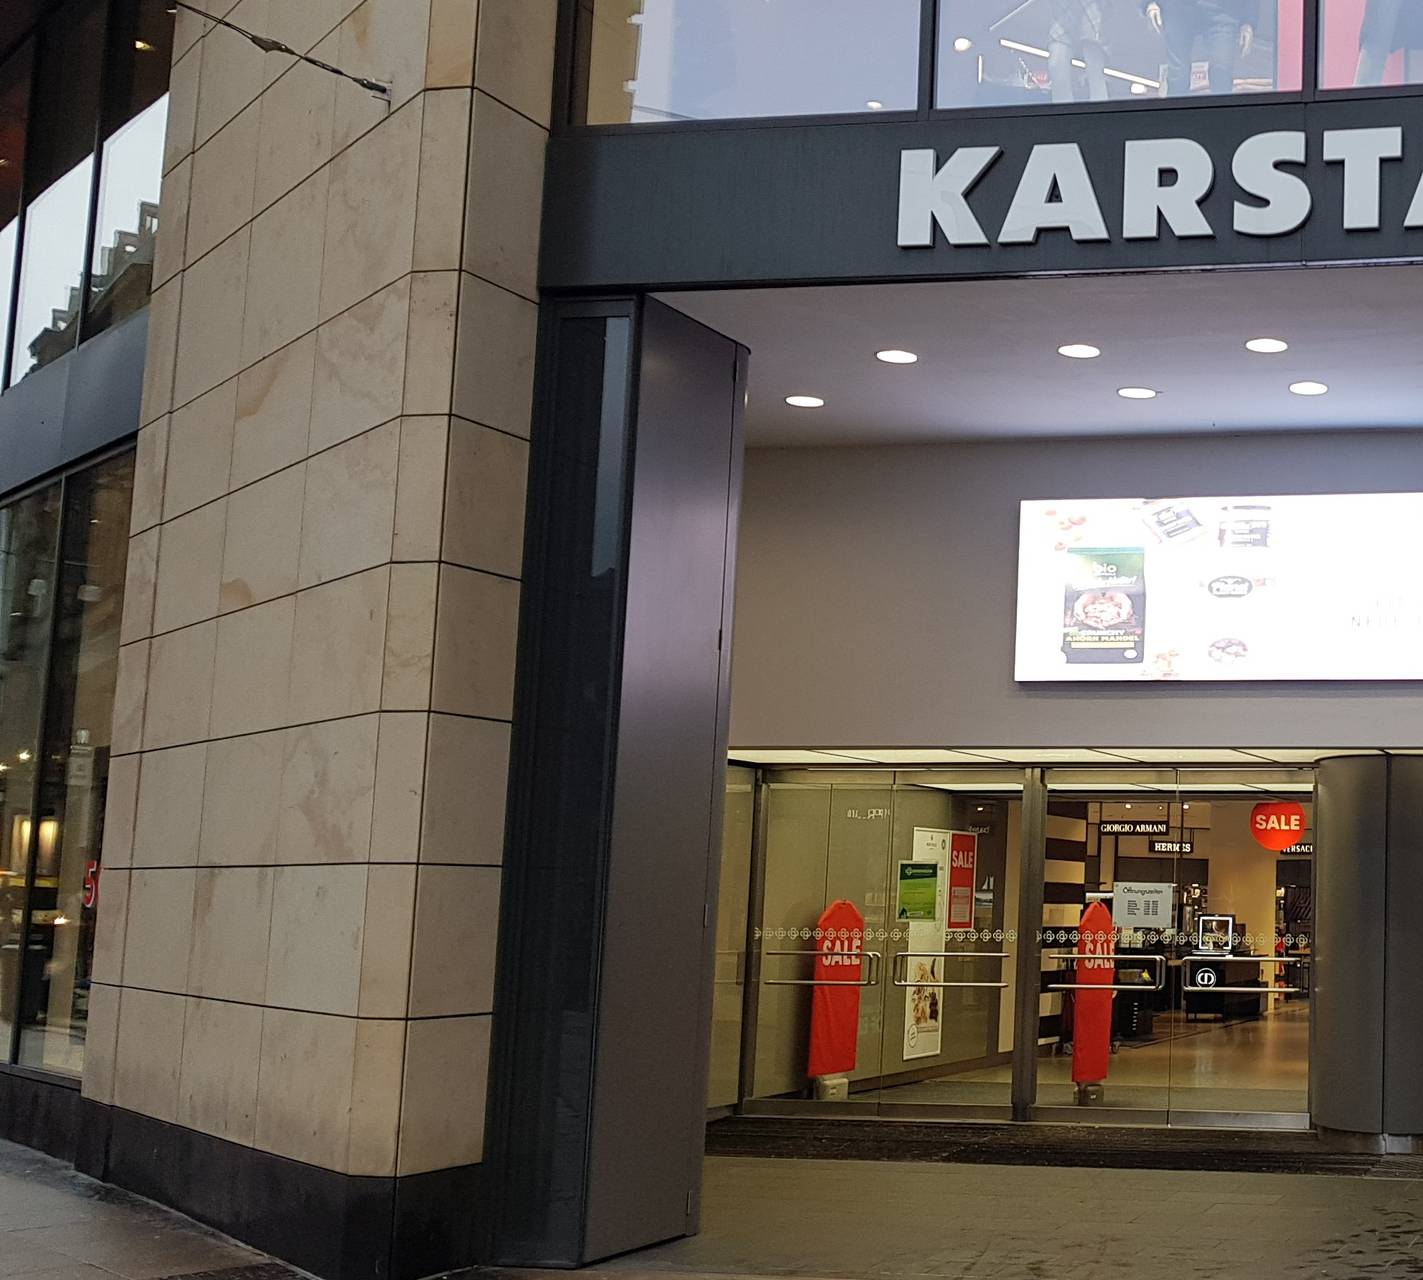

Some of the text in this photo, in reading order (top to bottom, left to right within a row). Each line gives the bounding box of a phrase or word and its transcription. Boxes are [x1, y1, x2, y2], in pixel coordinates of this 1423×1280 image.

[1100, 823, 1167, 833] GIORGIO ARMANI
[1255, 815, 1300, 831] SALE
[952, 850, 974, 869] SALE
[822, 939, 861, 966] SALE
